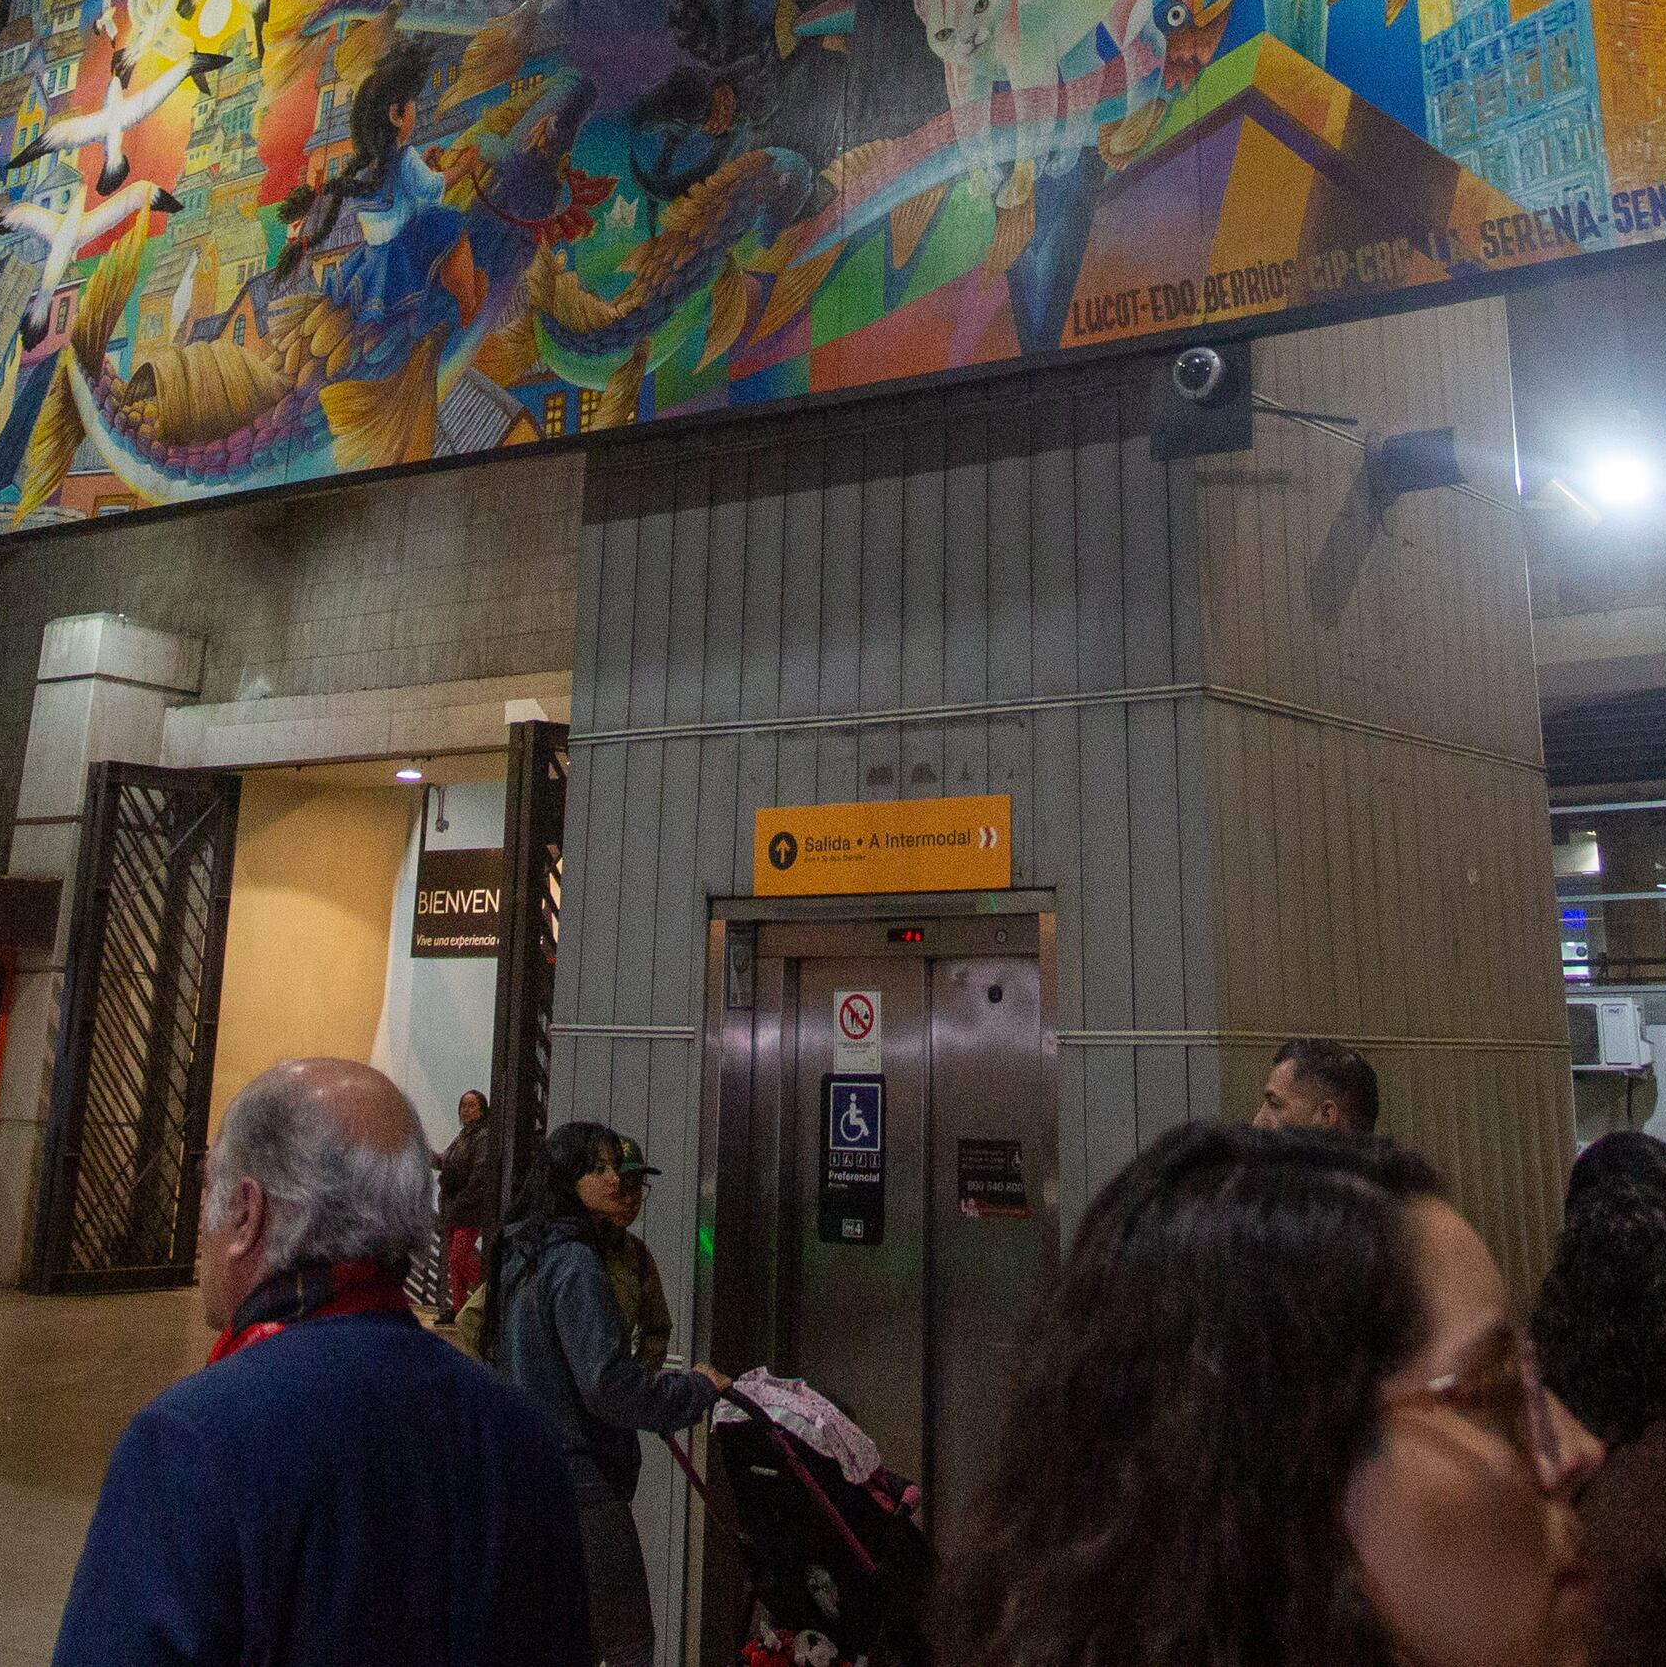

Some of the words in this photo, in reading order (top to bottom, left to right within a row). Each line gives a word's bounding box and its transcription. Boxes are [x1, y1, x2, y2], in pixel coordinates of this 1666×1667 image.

[804, 835, 851, 854] Salida
[869, 833, 881, 849] A
[885, 829, 971, 849] Intermodal
[417, 888, 501, 915] BIENVEN
[416, 934, 433, 947] Vive
[434, 936, 450, 947] una
[450, 934, 496, 950] experiencia
[828, 1169, 881, 1183] Preferencial
